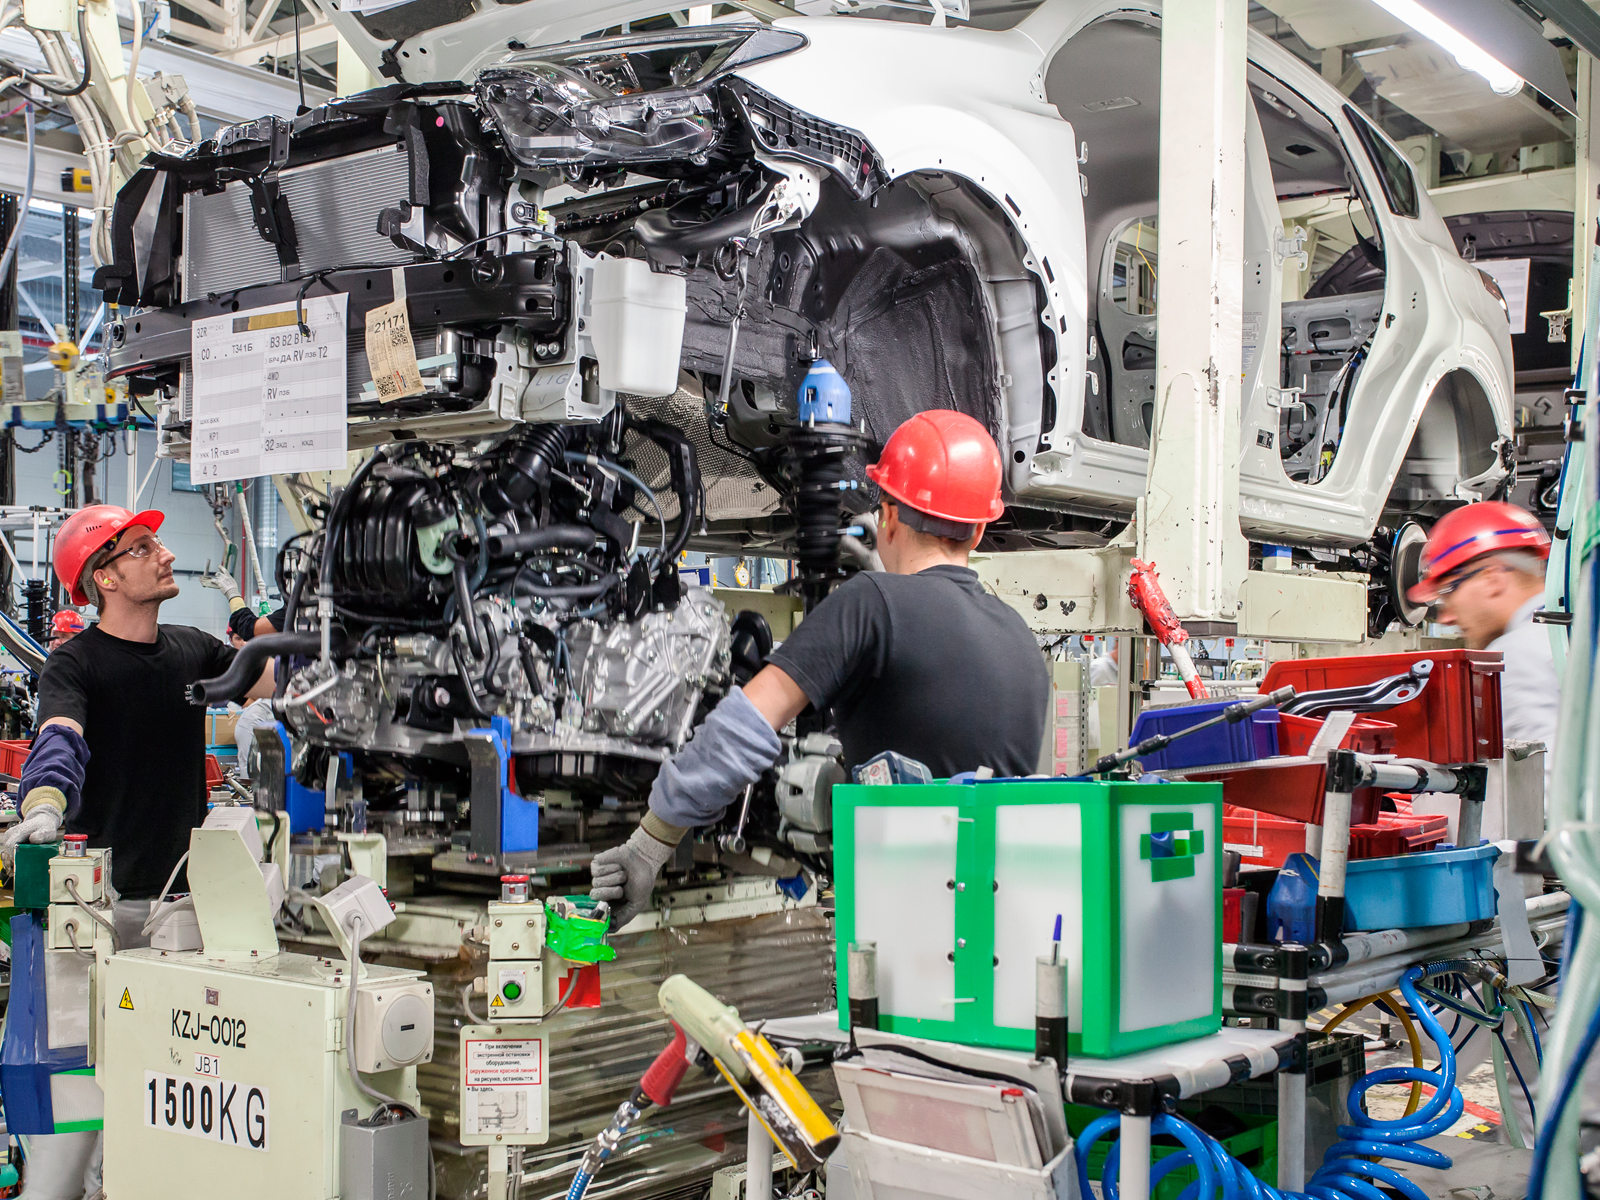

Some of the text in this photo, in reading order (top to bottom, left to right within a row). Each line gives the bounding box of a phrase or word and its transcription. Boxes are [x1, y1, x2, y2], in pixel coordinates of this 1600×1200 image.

[374, 312, 405, 334] 21171
[294, 350, 304, 362] RV
[267, 388, 278, 400] RV
[265, 439, 274, 452] 32
[203, 466, 207, 476] 4
[213, 464, 218, 476] 2
[172, 1008, 246, 1049] KZJ-0012
[196, 1056, 218, 1075] JB1
